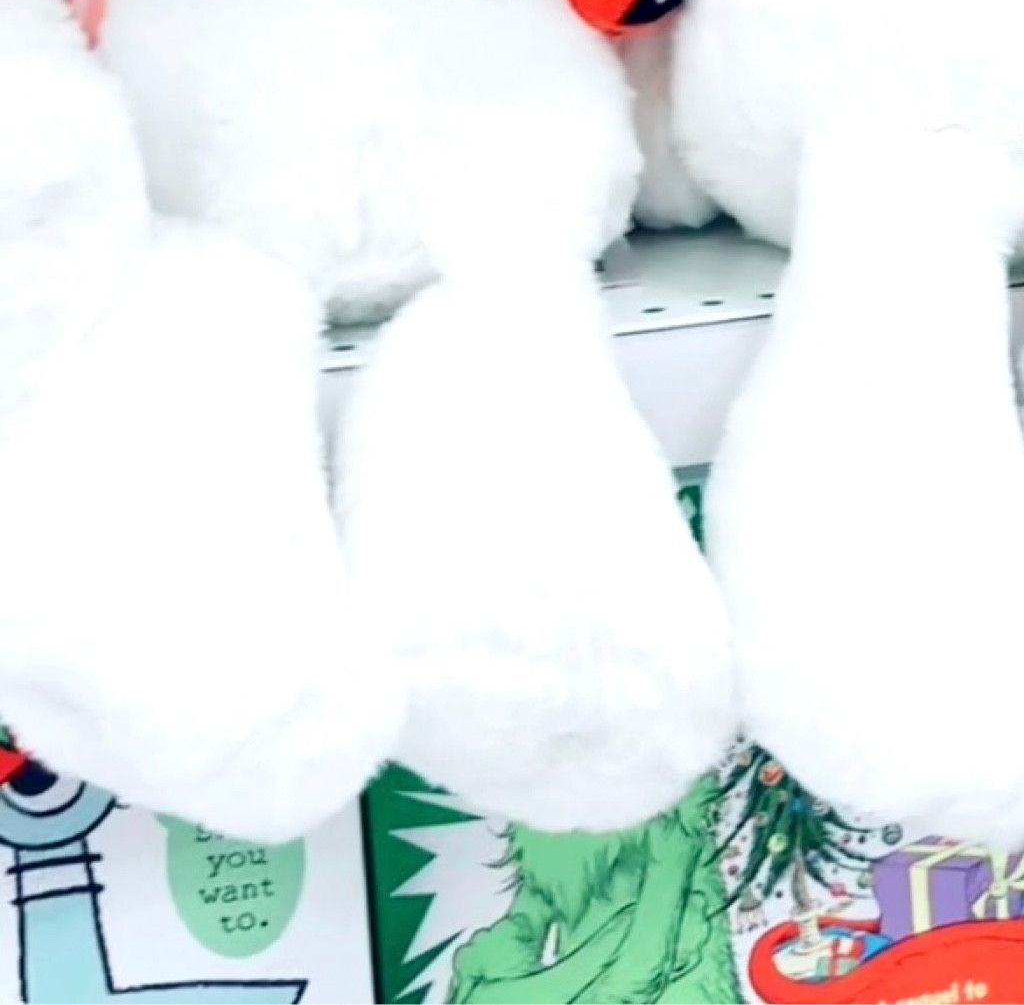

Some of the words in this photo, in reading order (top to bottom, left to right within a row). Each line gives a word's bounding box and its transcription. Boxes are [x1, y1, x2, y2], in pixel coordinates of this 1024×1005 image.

[206, 848, 268, 878] you
[199, 878, 274, 904] want
[221, 912, 269, 933] to.
[964, 979, 988, 1001] to
